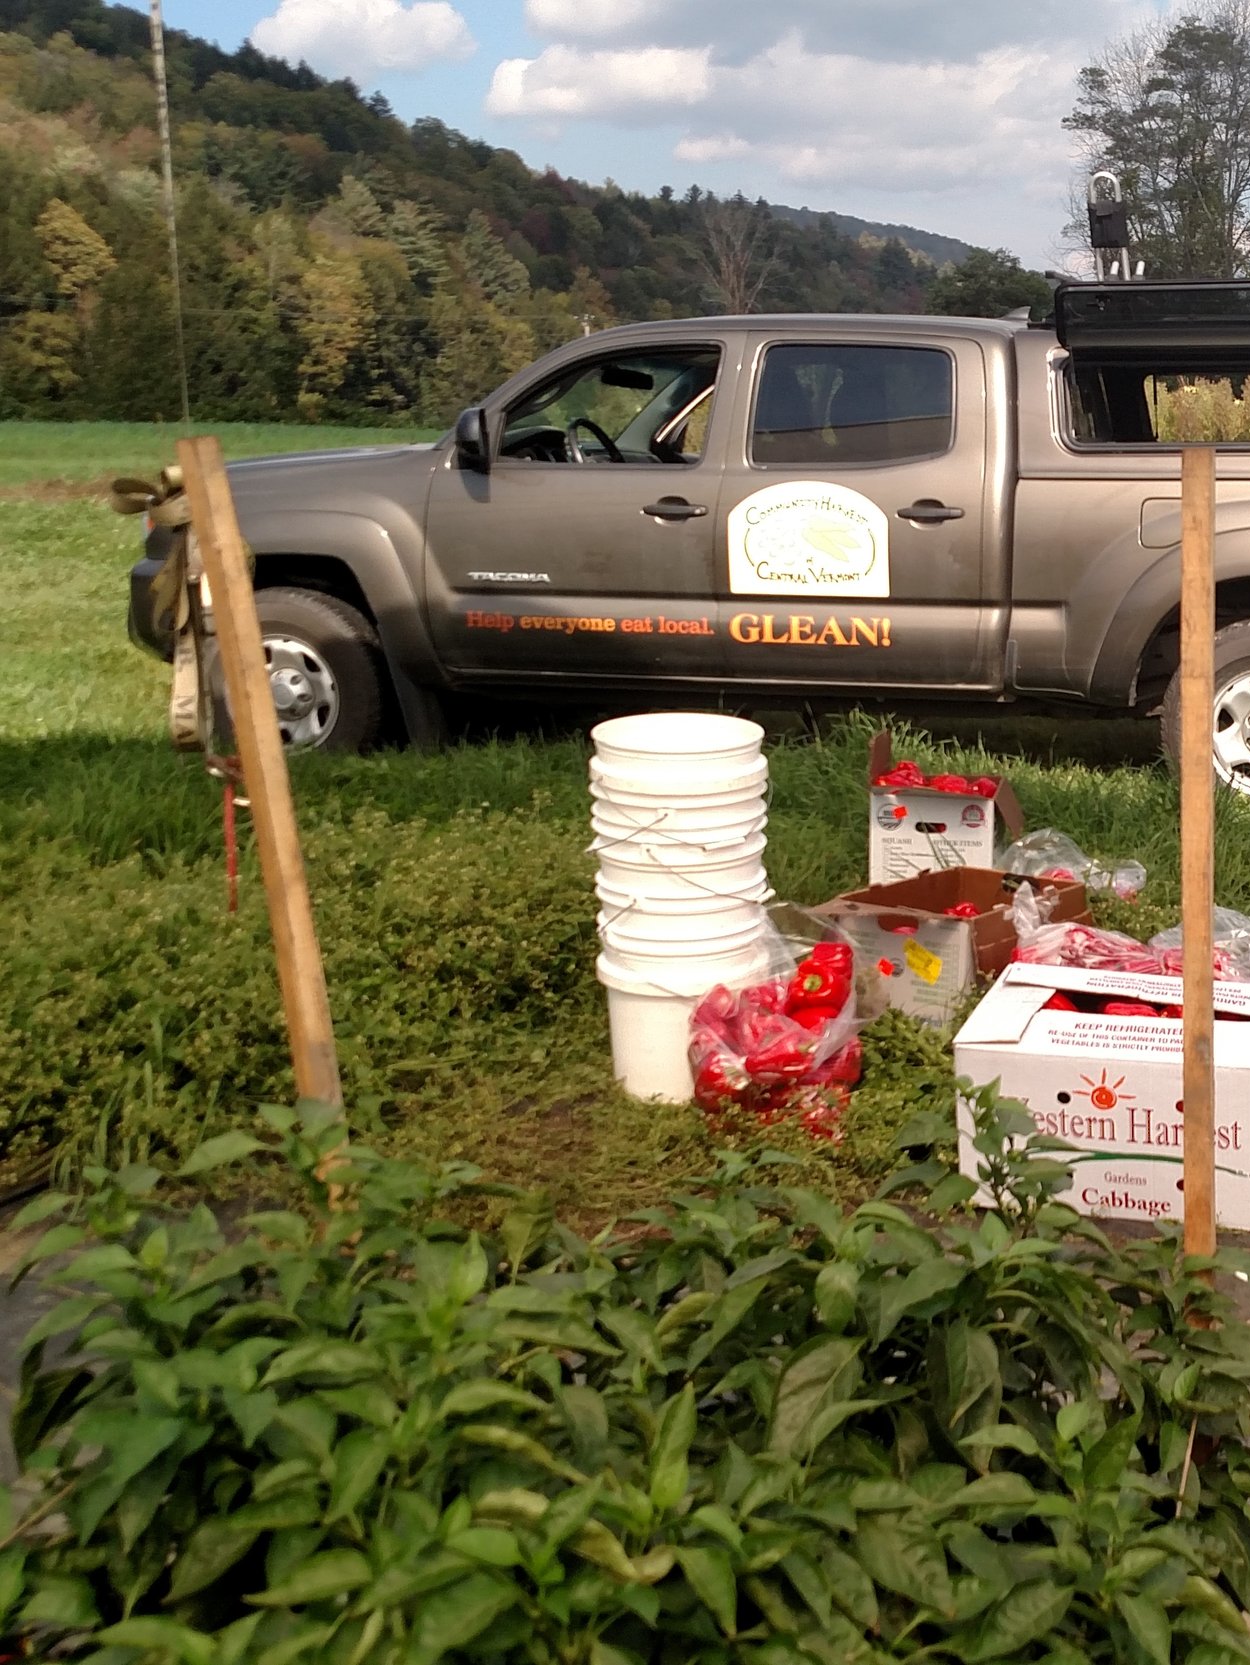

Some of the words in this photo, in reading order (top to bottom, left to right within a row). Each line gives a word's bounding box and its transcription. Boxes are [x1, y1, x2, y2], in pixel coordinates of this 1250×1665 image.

[467, 572, 550, 582] TACOMA
[466, 610, 514, 632] Help
[519, 614, 616, 635] everyone
[620, 616, 653, 632] eat
[657, 615, 715, 635] local.
[729, 612, 893, 648] GLEAN!
[1074, 1021, 1103, 1032] KEEP
[1105, 1023, 1184, 1036] REFRIGERATE
[1022, 1099, 1117, 1142] estern
[1104, 1171, 1148, 1186] Gardens
[1081, 1187, 1172, 1217] Cabbage
